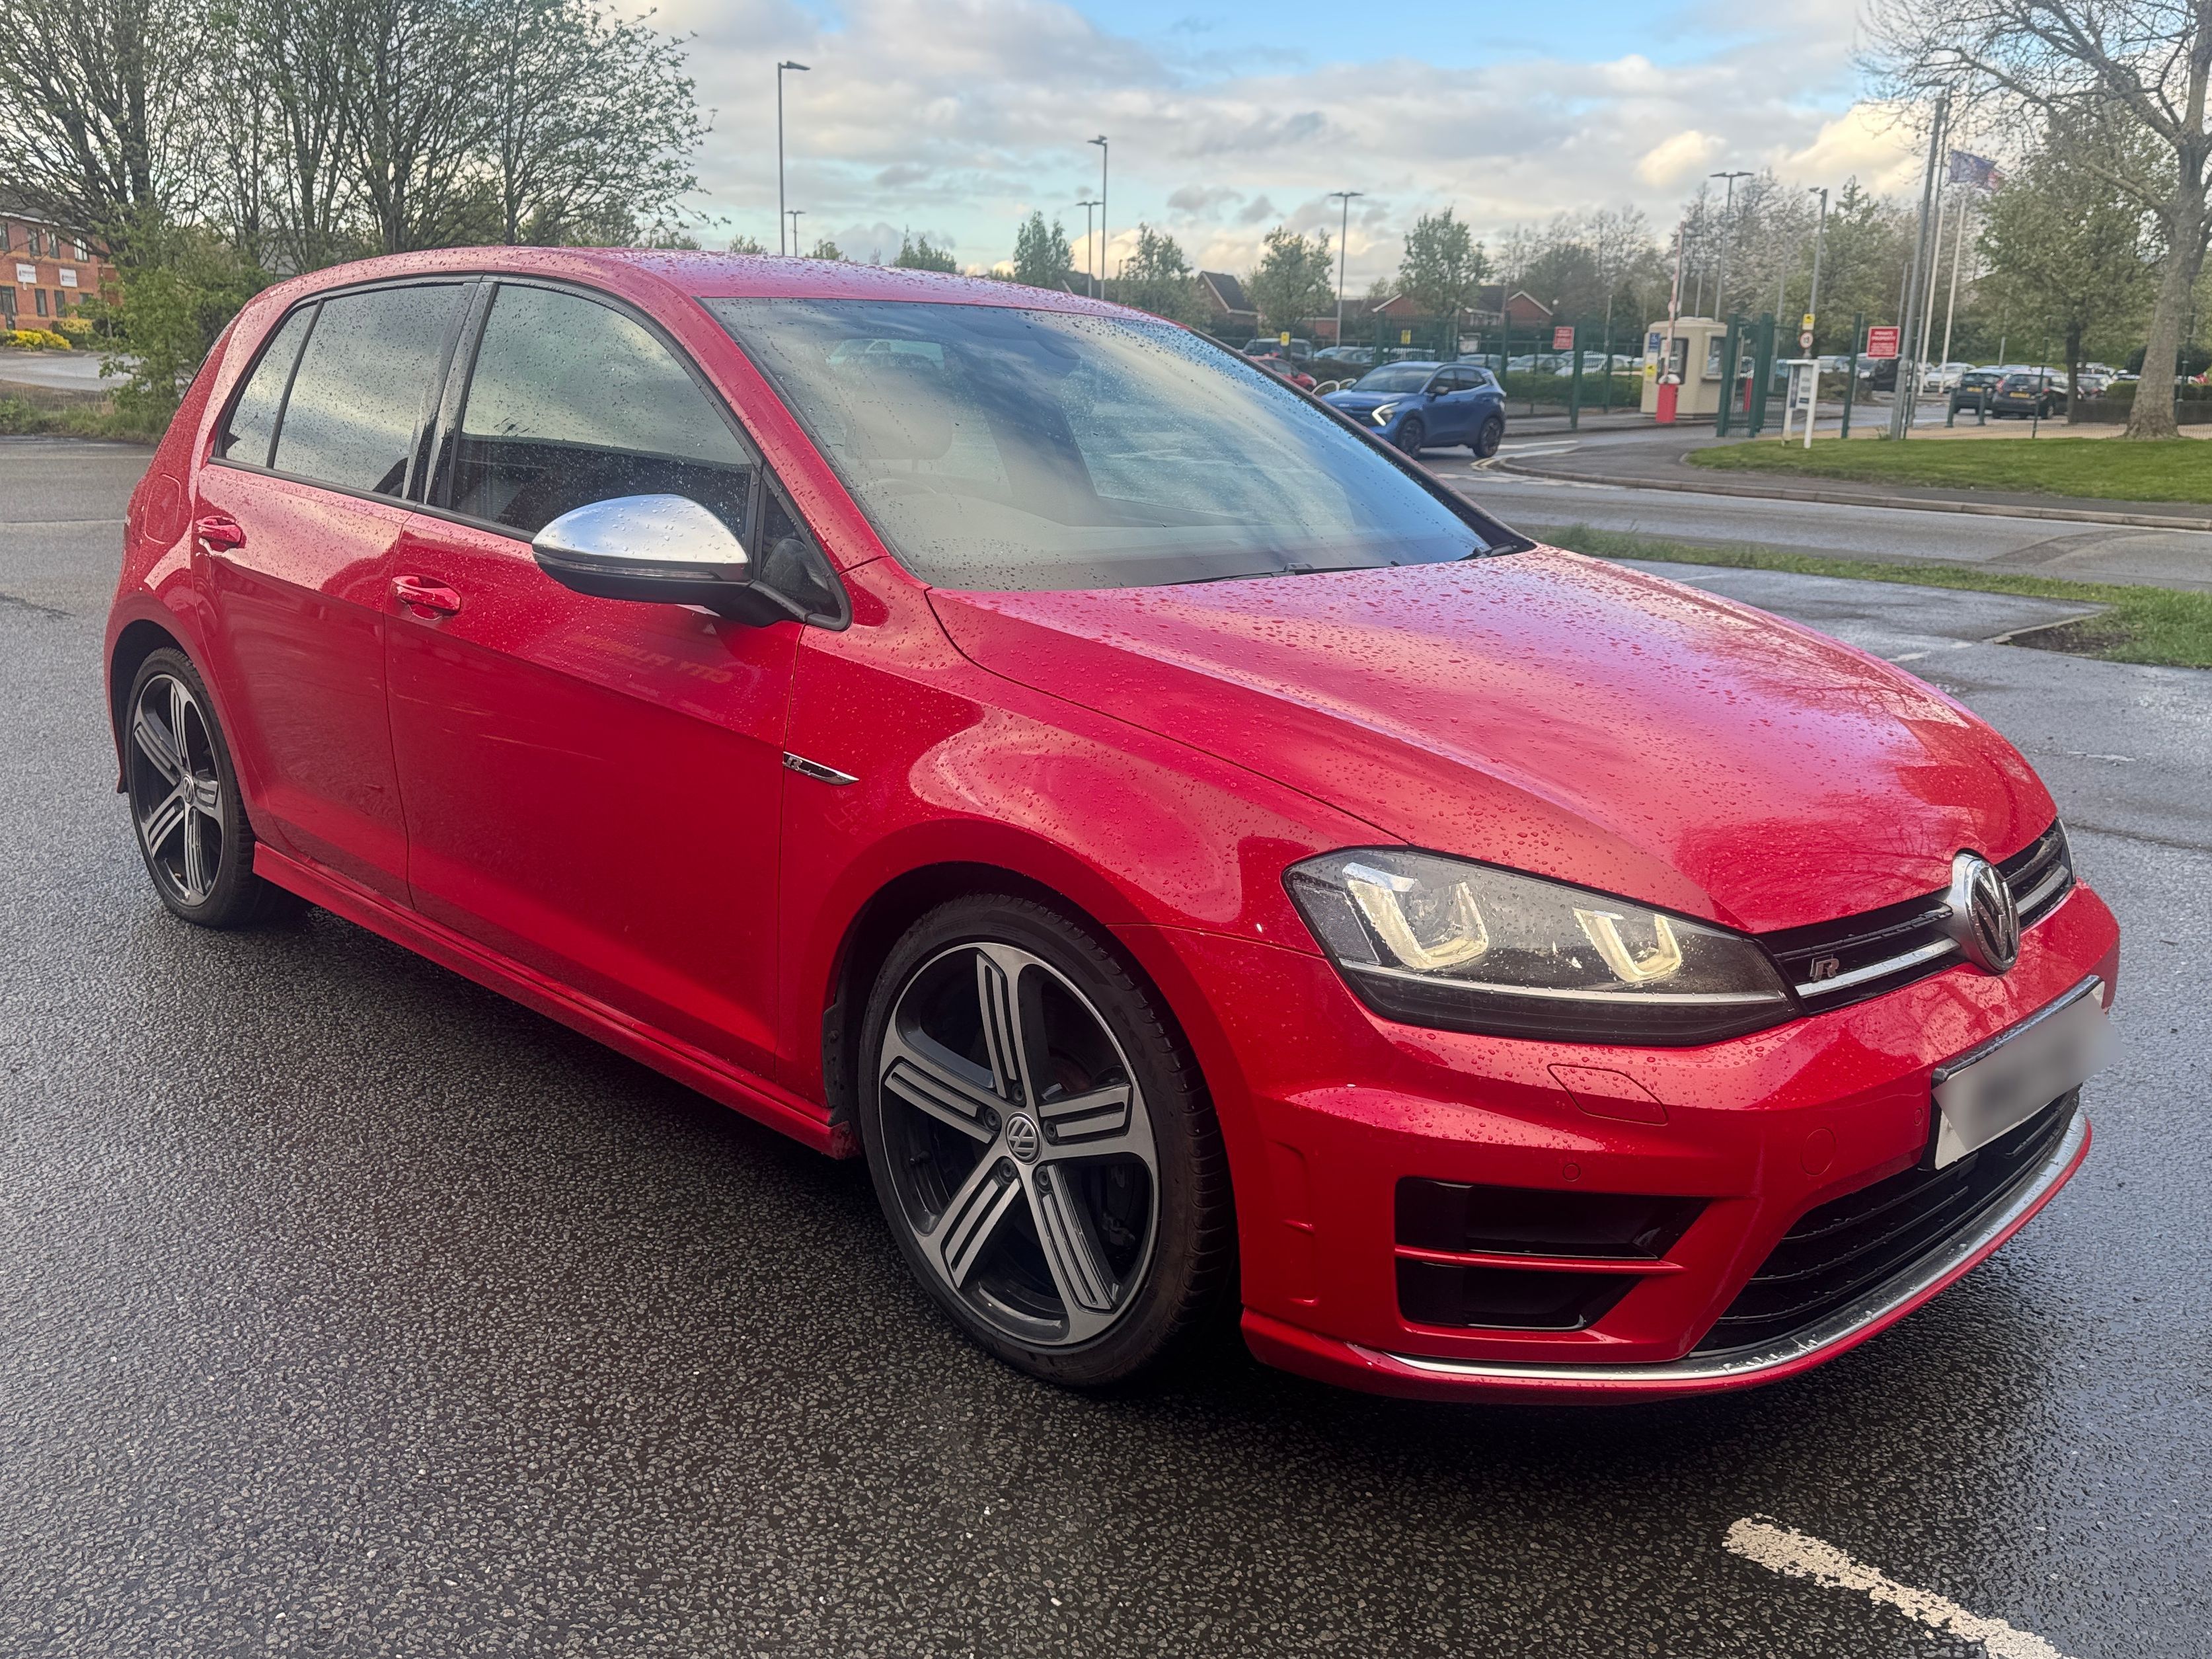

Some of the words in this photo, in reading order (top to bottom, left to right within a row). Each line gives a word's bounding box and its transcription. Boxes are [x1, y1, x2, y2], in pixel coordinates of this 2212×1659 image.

[786, 756, 803, 771] R
[1811, 956, 1840, 982] R
[1006, 1113, 1040, 1163] VW
